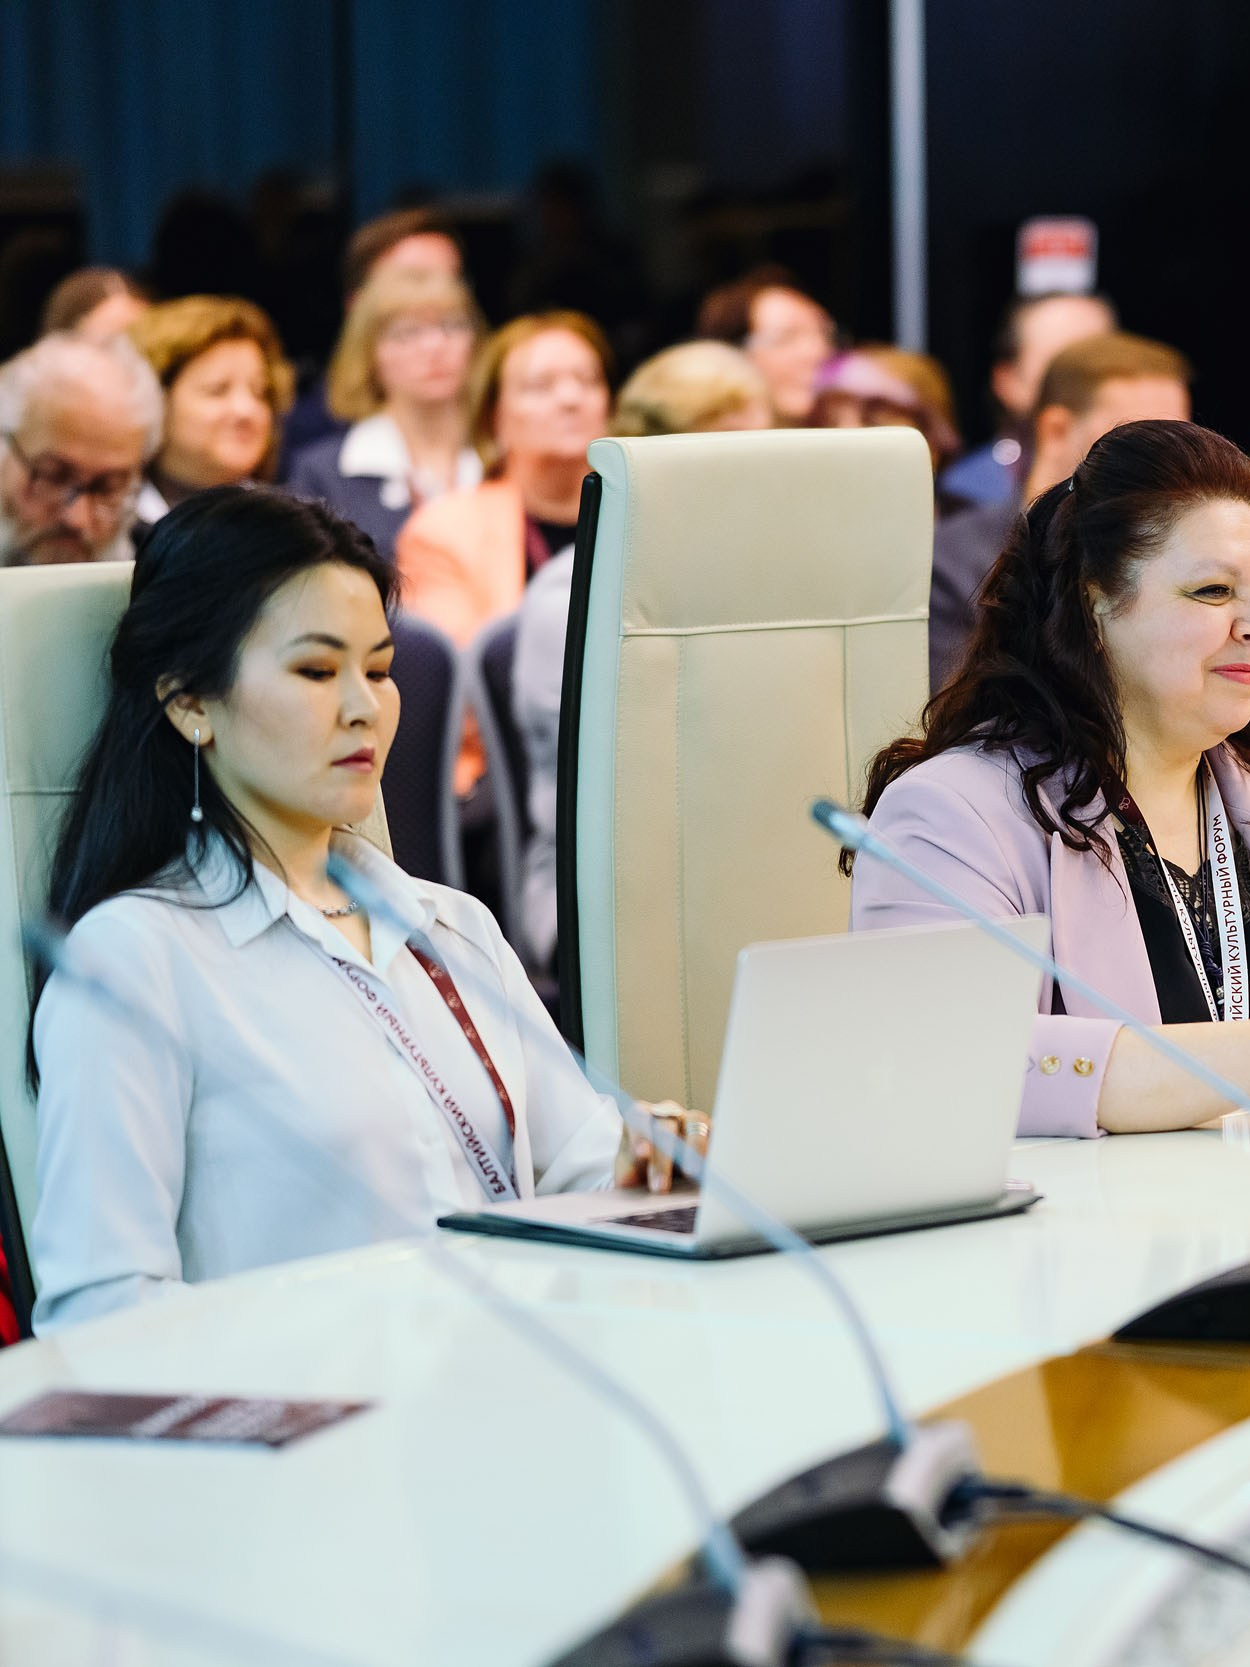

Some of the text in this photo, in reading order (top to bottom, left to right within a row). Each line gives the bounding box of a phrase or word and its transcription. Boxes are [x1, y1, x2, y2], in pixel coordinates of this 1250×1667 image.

[1213, 813, 1228, 865] ФОРУМ
[1215, 866, 1240, 963] КУЛЬТУРНЫЙ
[375, 1003, 448, 1097] КУЛЬТУРНЫЙ
[444, 1095, 506, 1195] БАЛТИЙСКИЙ
